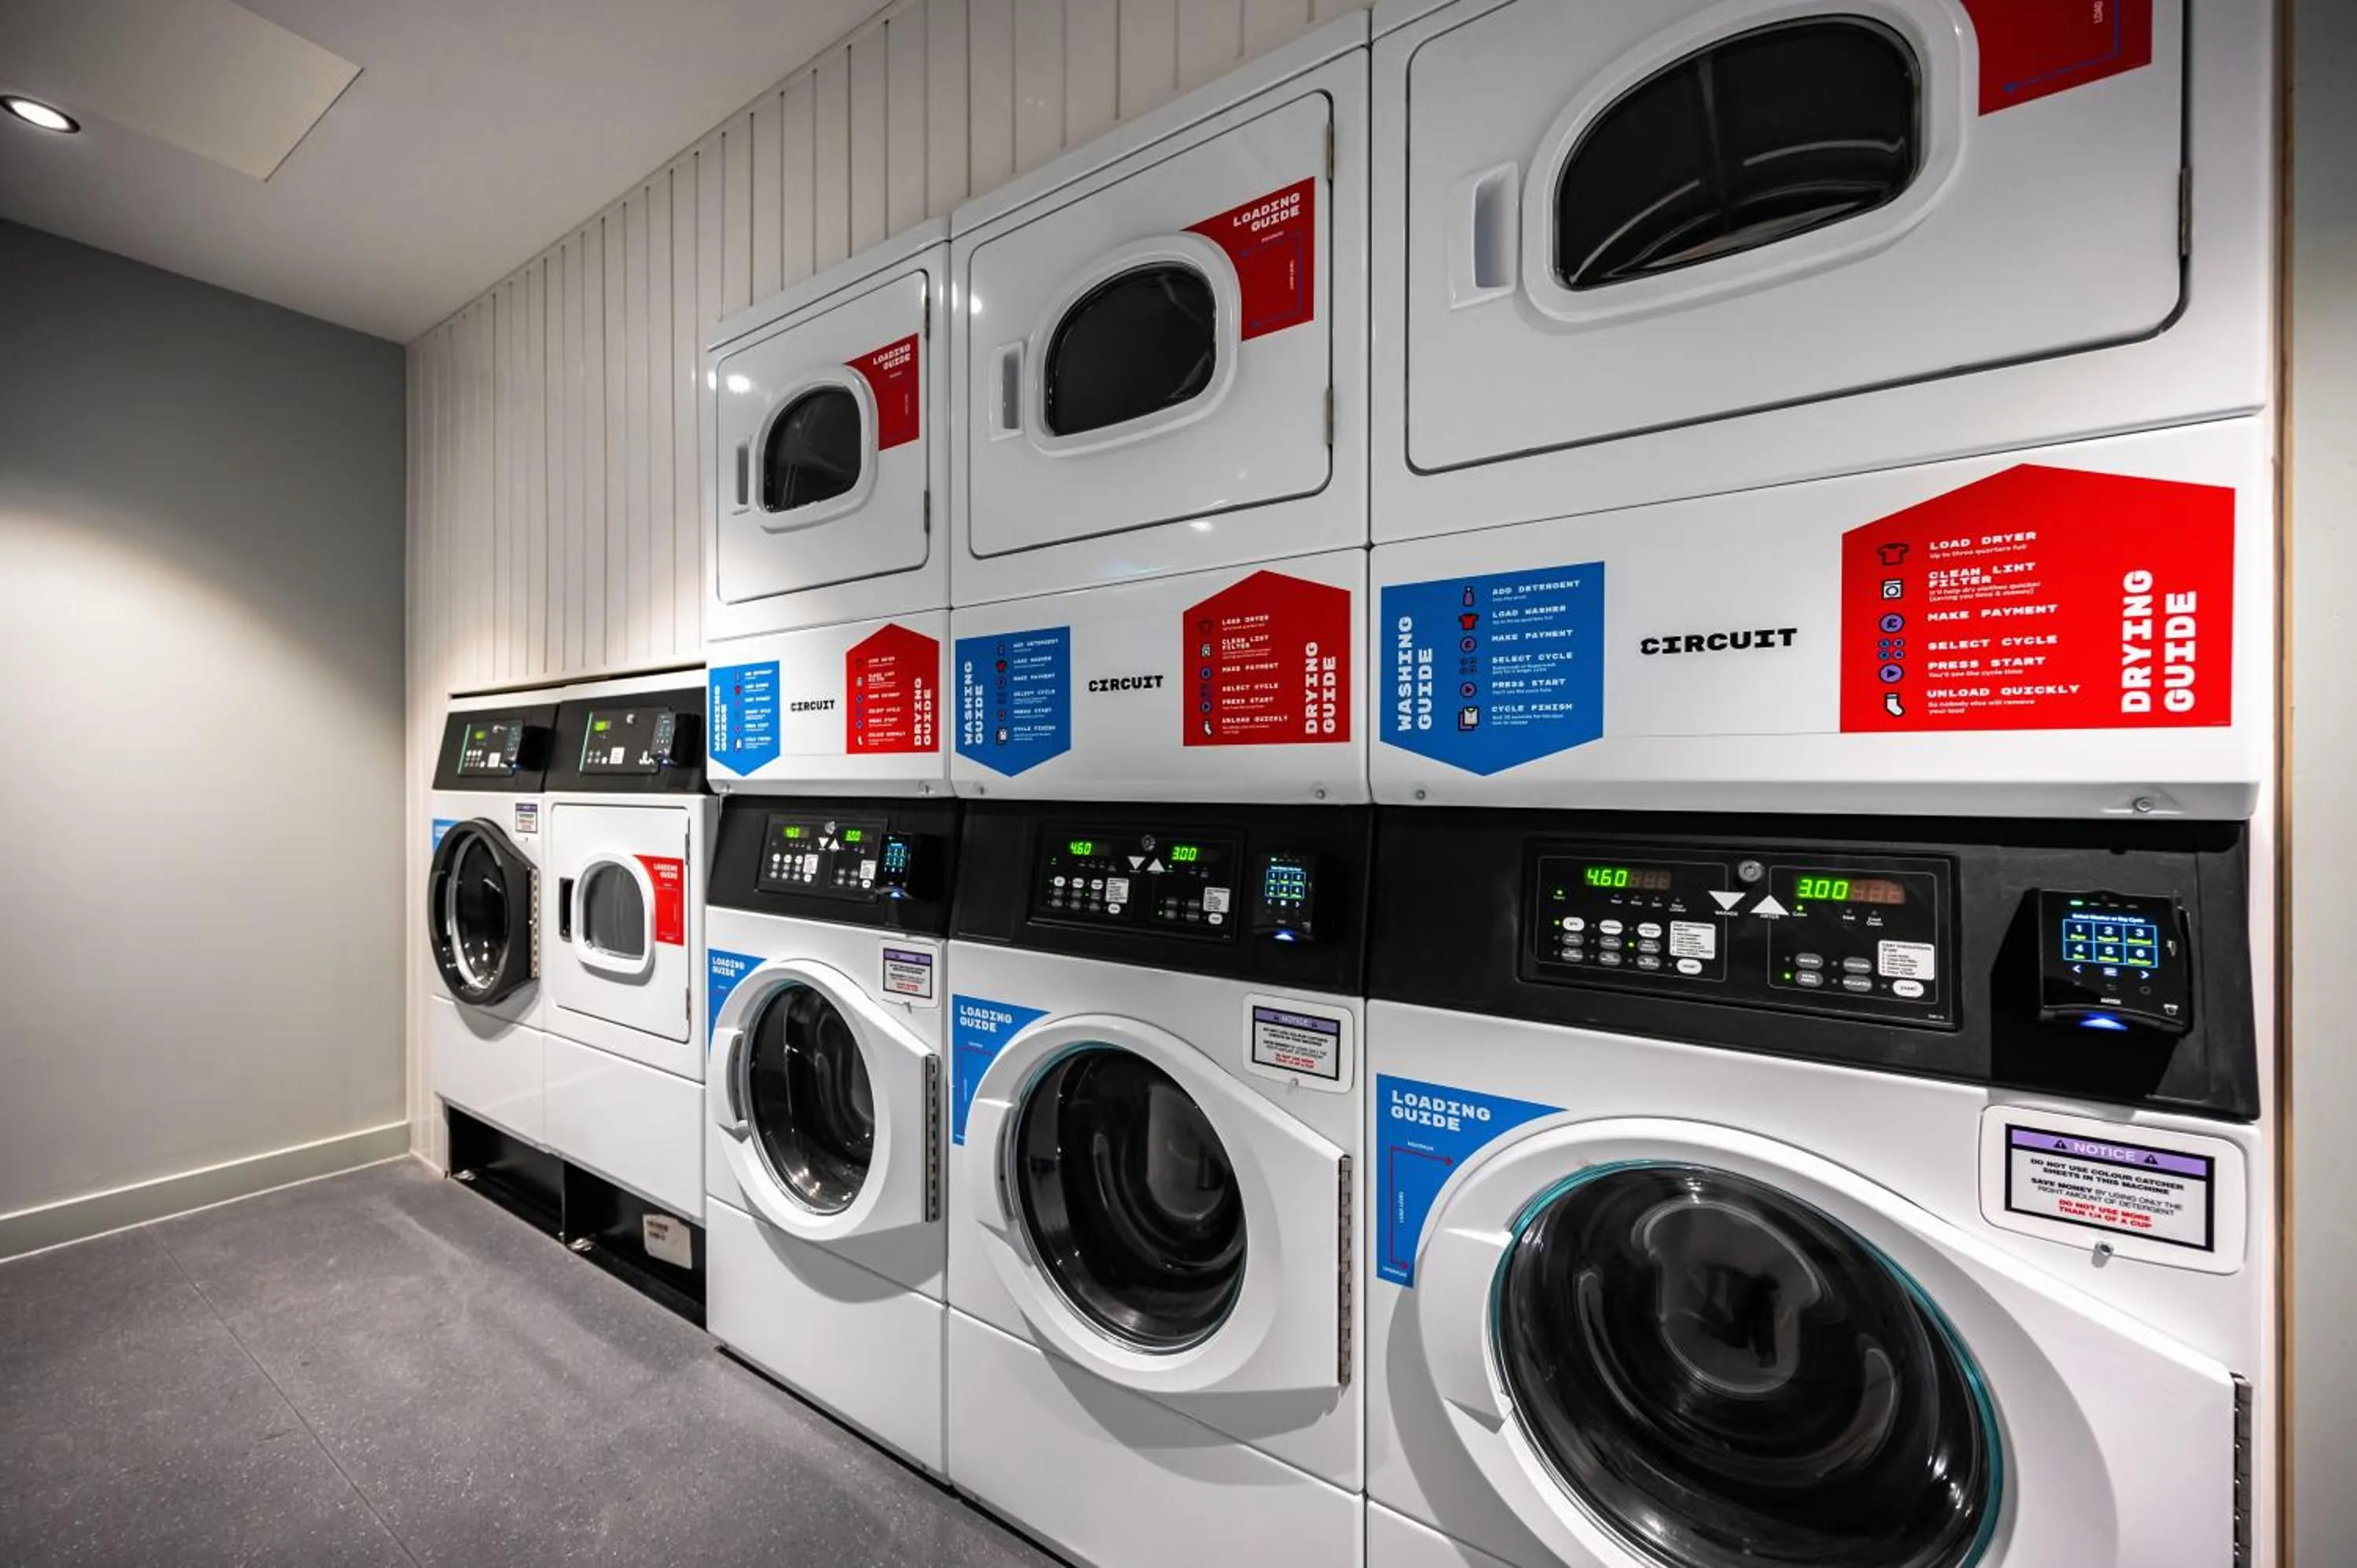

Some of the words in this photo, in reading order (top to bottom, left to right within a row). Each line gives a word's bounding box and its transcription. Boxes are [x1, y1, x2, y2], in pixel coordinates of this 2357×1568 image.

[1233, 192, 1300, 227] LOADING
[1251, 204, 1300, 233] GUIDE
[1930, 538, 1971, 550] LOAD
[1981, 531, 2037, 545] DRYER
[1929, 568, 1981, 579] CLEAN
[1992, 562, 2036, 574] LINT
[1929, 575, 1992, 588] FILTER
[1492, 609, 1519, 618] LOAD
[1927, 610, 1970, 621] MAKE
[1981, 604, 2058, 618] PAYMENT
[1491, 633, 1518, 642] MAKE
[1525, 629, 1574, 639] PAYMENT
[1640, 628, 1798, 655] CIRCUIT
[1927, 639, 1991, 650] SELECT
[2001, 634, 2058, 647] CYCLE
[2121, 570, 2153, 713] DRYING
[1492, 654, 1532, 664] SELECT
[1538, 651, 1573, 661] CYCLE
[2164, 591, 2197, 713] GUIDE
[1927, 660, 1979, 670] PRESS
[1990, 657, 2046, 667] START
[1397, 616, 1413, 731] WASHING
[1089, 675, 1164, 692] CIRCUIT
[1305, 642, 1318, 735] DRYING
[1418, 647, 1433, 731] GUIDE
[1492, 680, 1524, 689] PRESS
[1531, 678, 1566, 687] START
[1926, 687, 1990, 698] UNLOAD
[2000, 684, 2080, 696] QUICKLY
[964, 661, 973, 745] WASHING
[1323, 656, 1336, 734] GUIDE
[791, 700, 835, 712] CIRCUIT
[975, 685, 984, 745] GUIDE
[1587, 868, 1628, 886] 4.60
[1798, 879, 1849, 900] 3.00
[2104, 926, 2113, 935] 2
[2135, 929, 2144, 937] 3
[2105, 946, 2114, 954] 5
[960, 1005, 1013, 1024] LOADING
[960, 1016, 998, 1033] GUIDE
[1391, 1090, 1490, 1121] LOADING
[1391, 1105, 1461, 1132] GUIDE
[2073, 1142, 2136, 1162] NOTICE
[2043, 1167, 2080, 1178] SHEETS
[2095, 1176, 2119, 1185] THIS
[2122, 1181, 2170, 1195] MACHINE
[2046, 1160, 2066, 1169] NOT
[2069, 1164, 2088, 1173] USE
[2091, 1168, 2132, 1181] COLOUR
[2135, 1176, 2184, 1190] CATCHER
[2031, 1178, 2056, 1186] SAVE
[2058, 1182, 2092, 1192] MONEY
[2075, 1202, 2095, 1211] NOT
[2121, 1211, 2150, 1221] MORE
